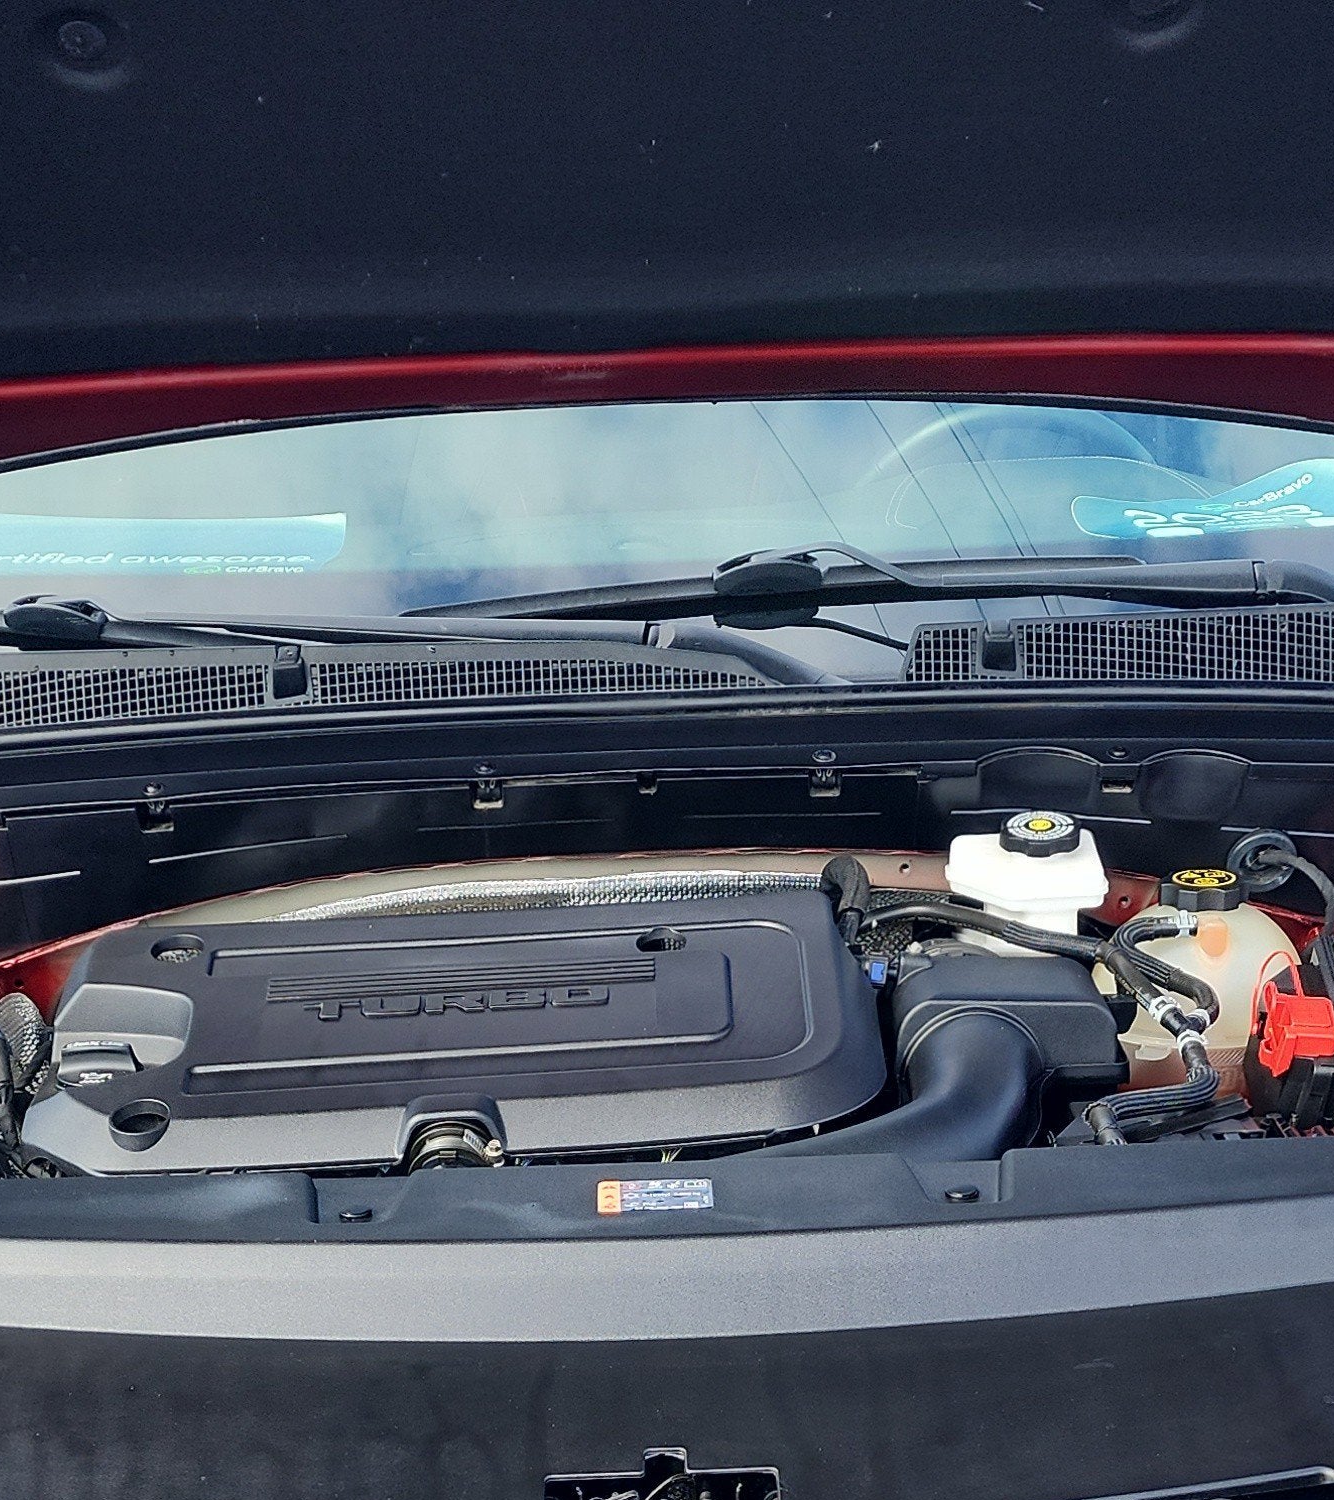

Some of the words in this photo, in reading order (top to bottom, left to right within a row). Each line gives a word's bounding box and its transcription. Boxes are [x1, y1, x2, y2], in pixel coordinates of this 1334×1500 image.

[1232, 473, 1313, 508] CarBravo
[225, 565, 304, 574] CarBravo
[303, 985, 611, 1021] TURBO
